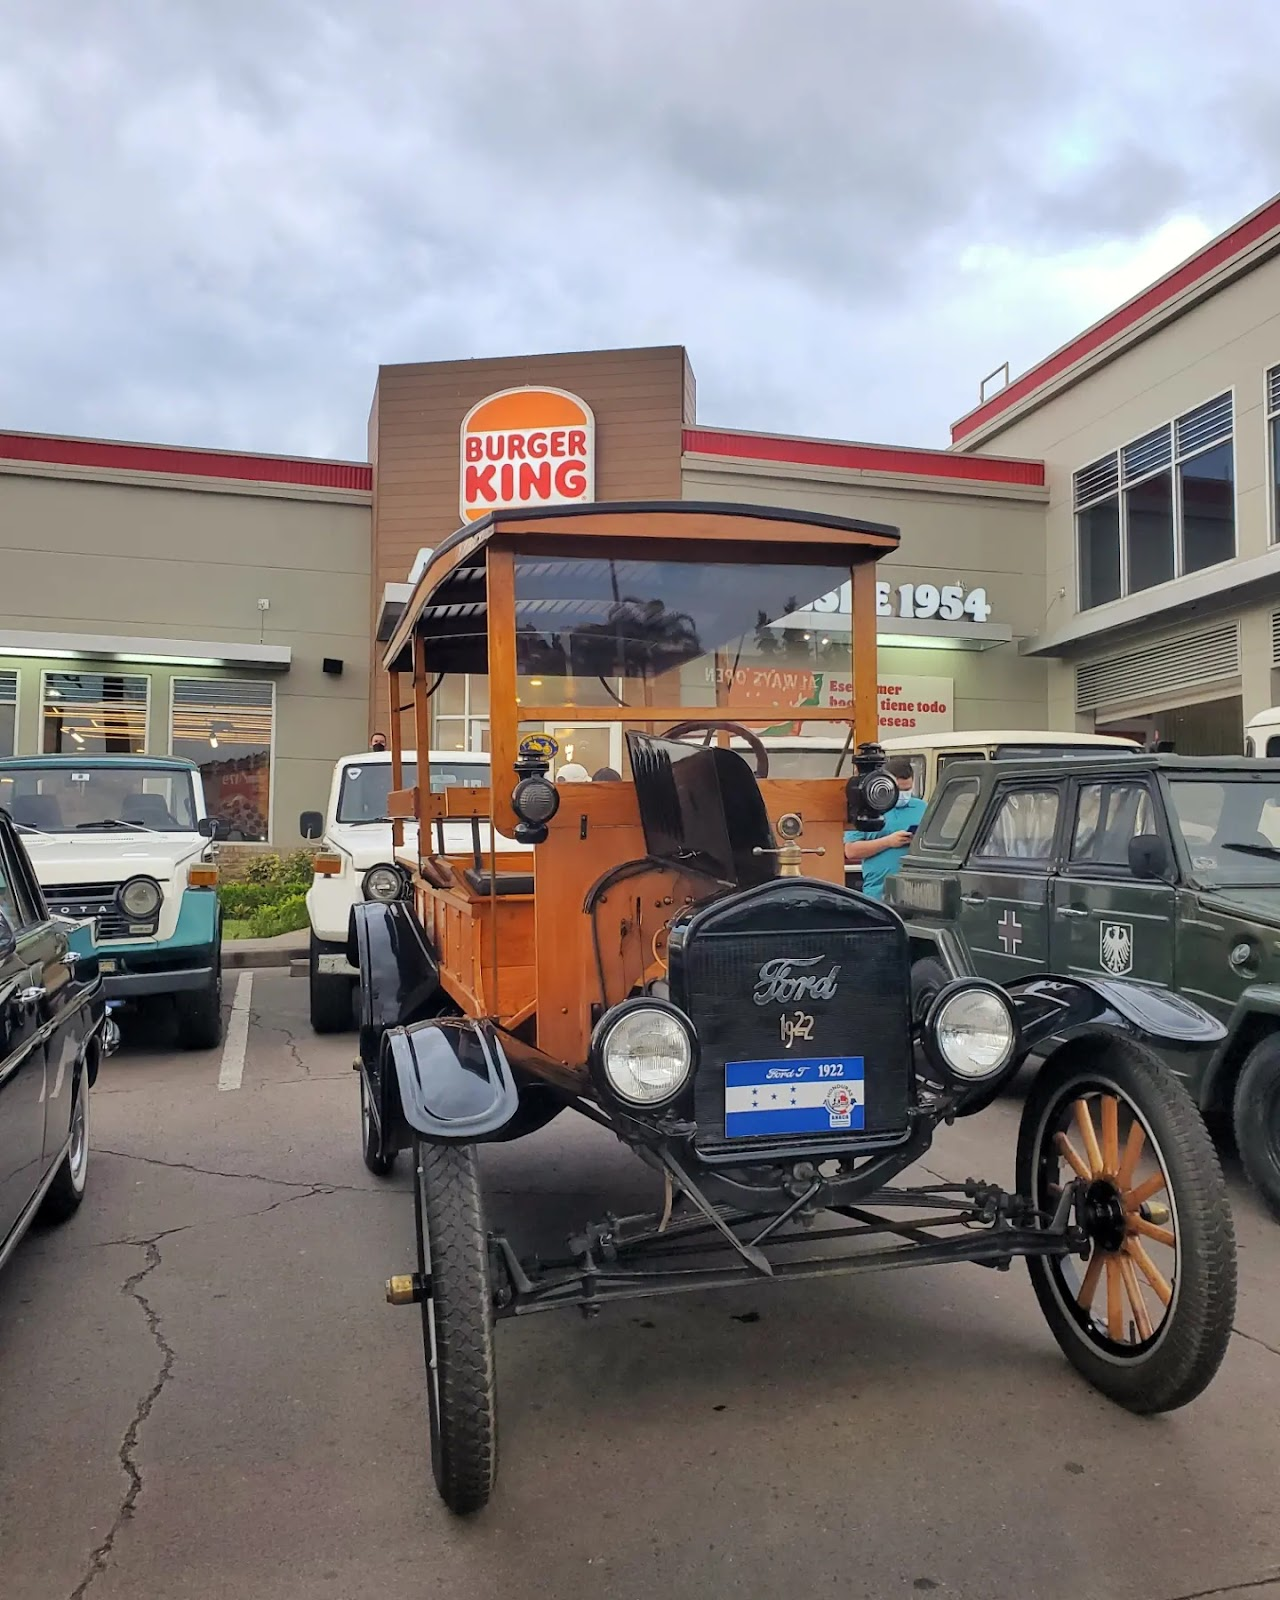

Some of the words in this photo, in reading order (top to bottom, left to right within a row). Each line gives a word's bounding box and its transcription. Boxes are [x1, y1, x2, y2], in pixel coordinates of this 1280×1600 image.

[465, 430, 587, 462] BURGER
[465, 460, 587, 503] KING
[899, 584, 991, 622] 1954
[829, 680, 853, 692] Ese
[881, 698, 914, 712] tiene
[917, 701, 946, 713] todo
[753, 954, 841, 1006] Ford
[779, 1010, 815, 1049] 1922
[766, 1068, 795, 1079] Ford
[818, 1063, 844, 1077] 1922
